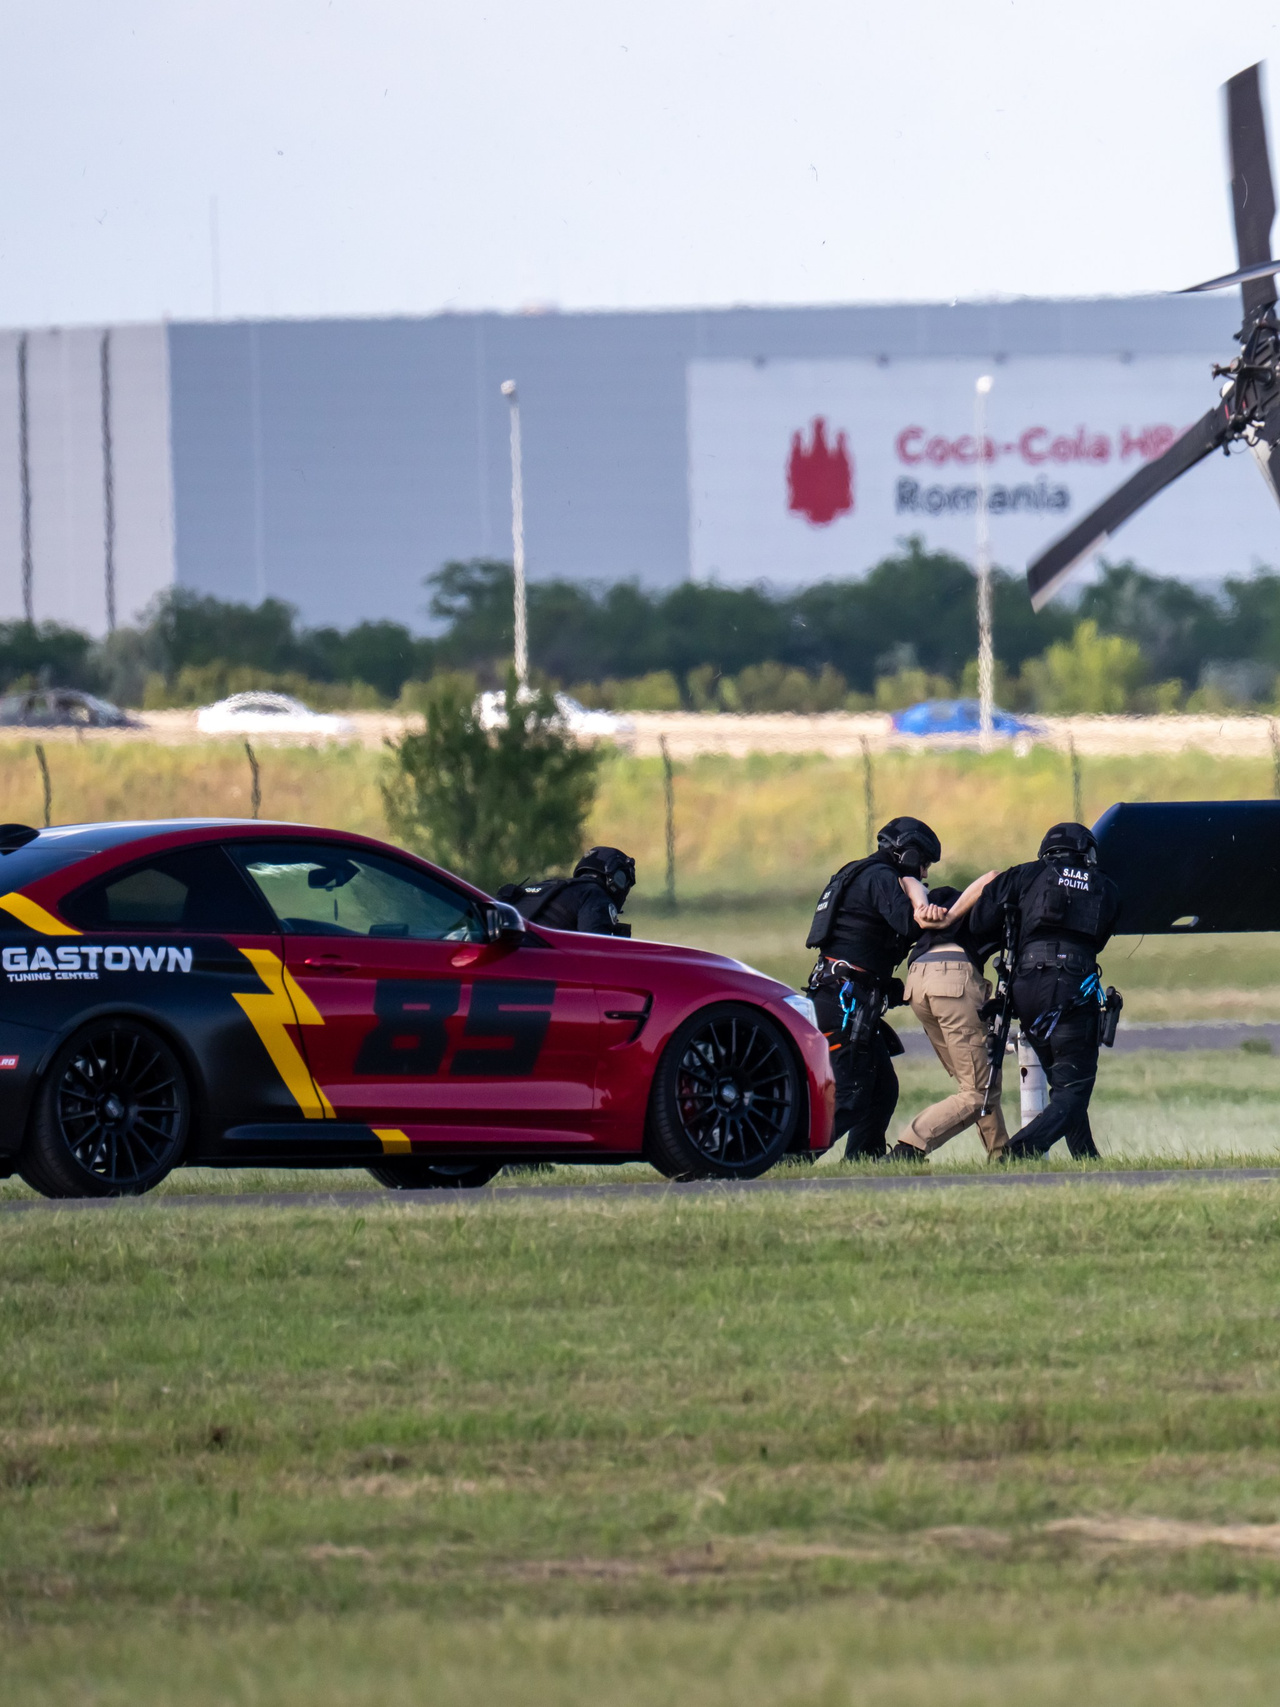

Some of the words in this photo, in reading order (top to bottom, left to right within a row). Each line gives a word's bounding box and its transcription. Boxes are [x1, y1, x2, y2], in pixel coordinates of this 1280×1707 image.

[896, 424, 1111, 466] Coca-Cola
[896, 473, 1071, 515] Romania
[1058, 877, 1089, 891] POLITIA
[2, 946, 193, 973] GASTOWN
[7, 972, 52, 983] TUNING
[55, 971, 99, 981] CENTER
[353, 979, 558, 1075] 85
